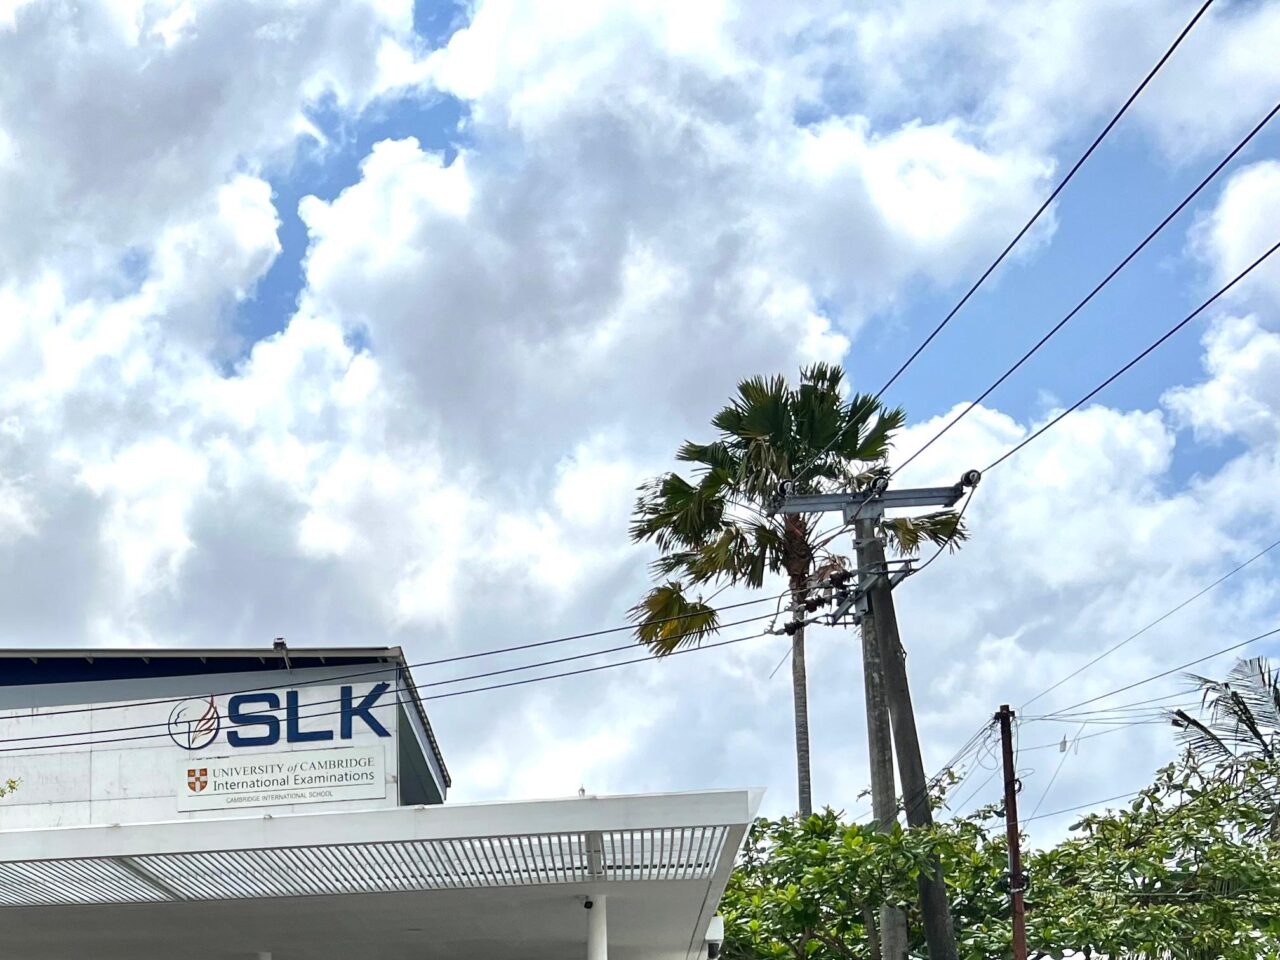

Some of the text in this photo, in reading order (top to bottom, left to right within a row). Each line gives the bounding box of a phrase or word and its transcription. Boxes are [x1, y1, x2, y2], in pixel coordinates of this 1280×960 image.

[226, 681, 393, 748] SLK
[212, 757, 375, 778] UNIVERSITY of CAMBRIDGE
[213, 770, 375, 791] International Examinations
[226, 790, 334, 804] CAMBRIDGE INTERNATIONAL SCHOOL
